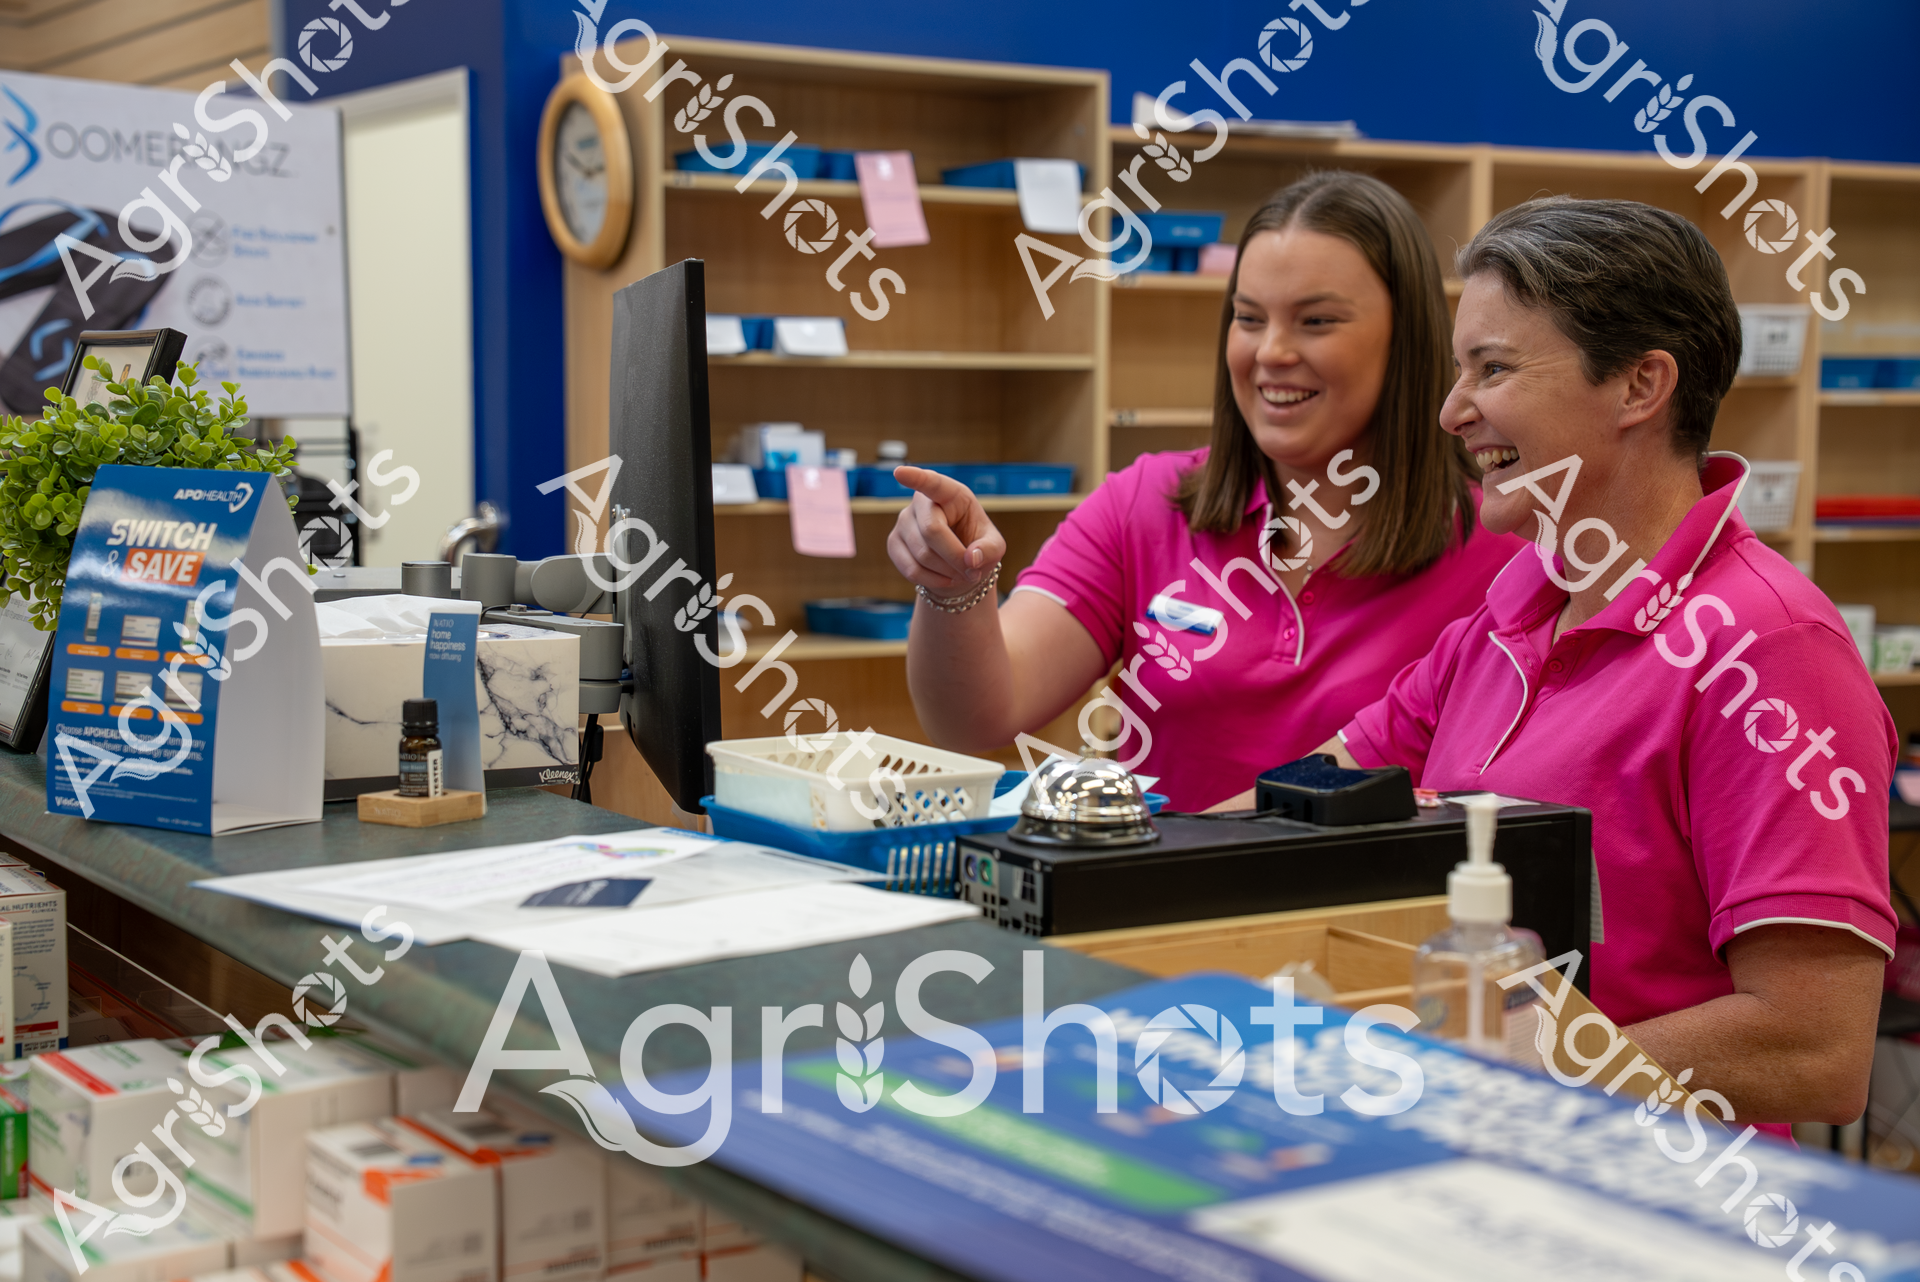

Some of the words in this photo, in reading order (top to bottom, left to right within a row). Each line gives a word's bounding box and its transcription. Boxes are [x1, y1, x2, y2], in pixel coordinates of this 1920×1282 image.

[174, 488, 244, 502] APOHEALTH
[106, 518, 218, 550] SWITCH
[100, 549, 120, 578] &
[127, 551, 199, 583] SAVE
[431, 629, 452, 640] home
[430, 639, 467, 652] happiness
[539, 768, 575, 784] Kleenex
[12, 900, 58, 911] NUTRIENTS
